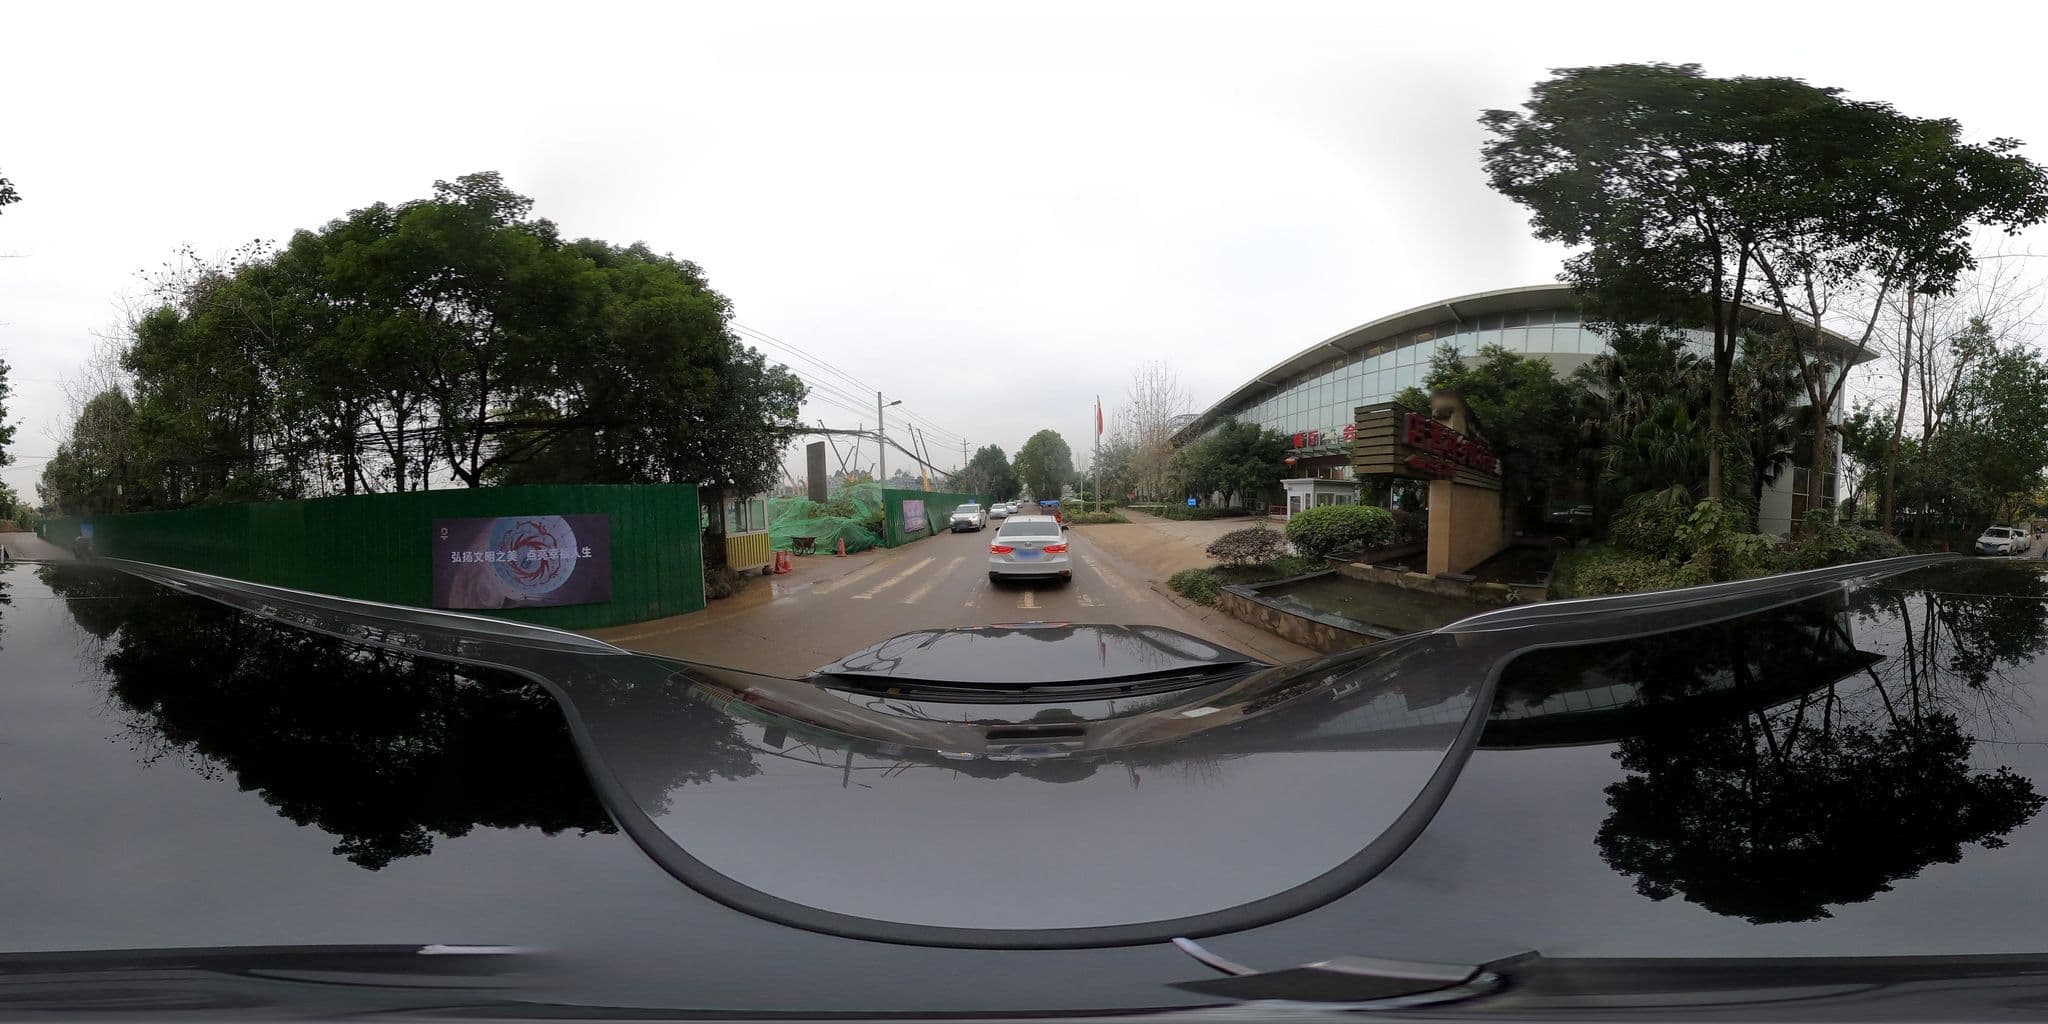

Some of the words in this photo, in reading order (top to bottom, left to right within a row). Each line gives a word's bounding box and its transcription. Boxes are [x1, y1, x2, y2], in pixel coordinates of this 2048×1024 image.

[451, 551, 518, 563] 弘扬文明之美
